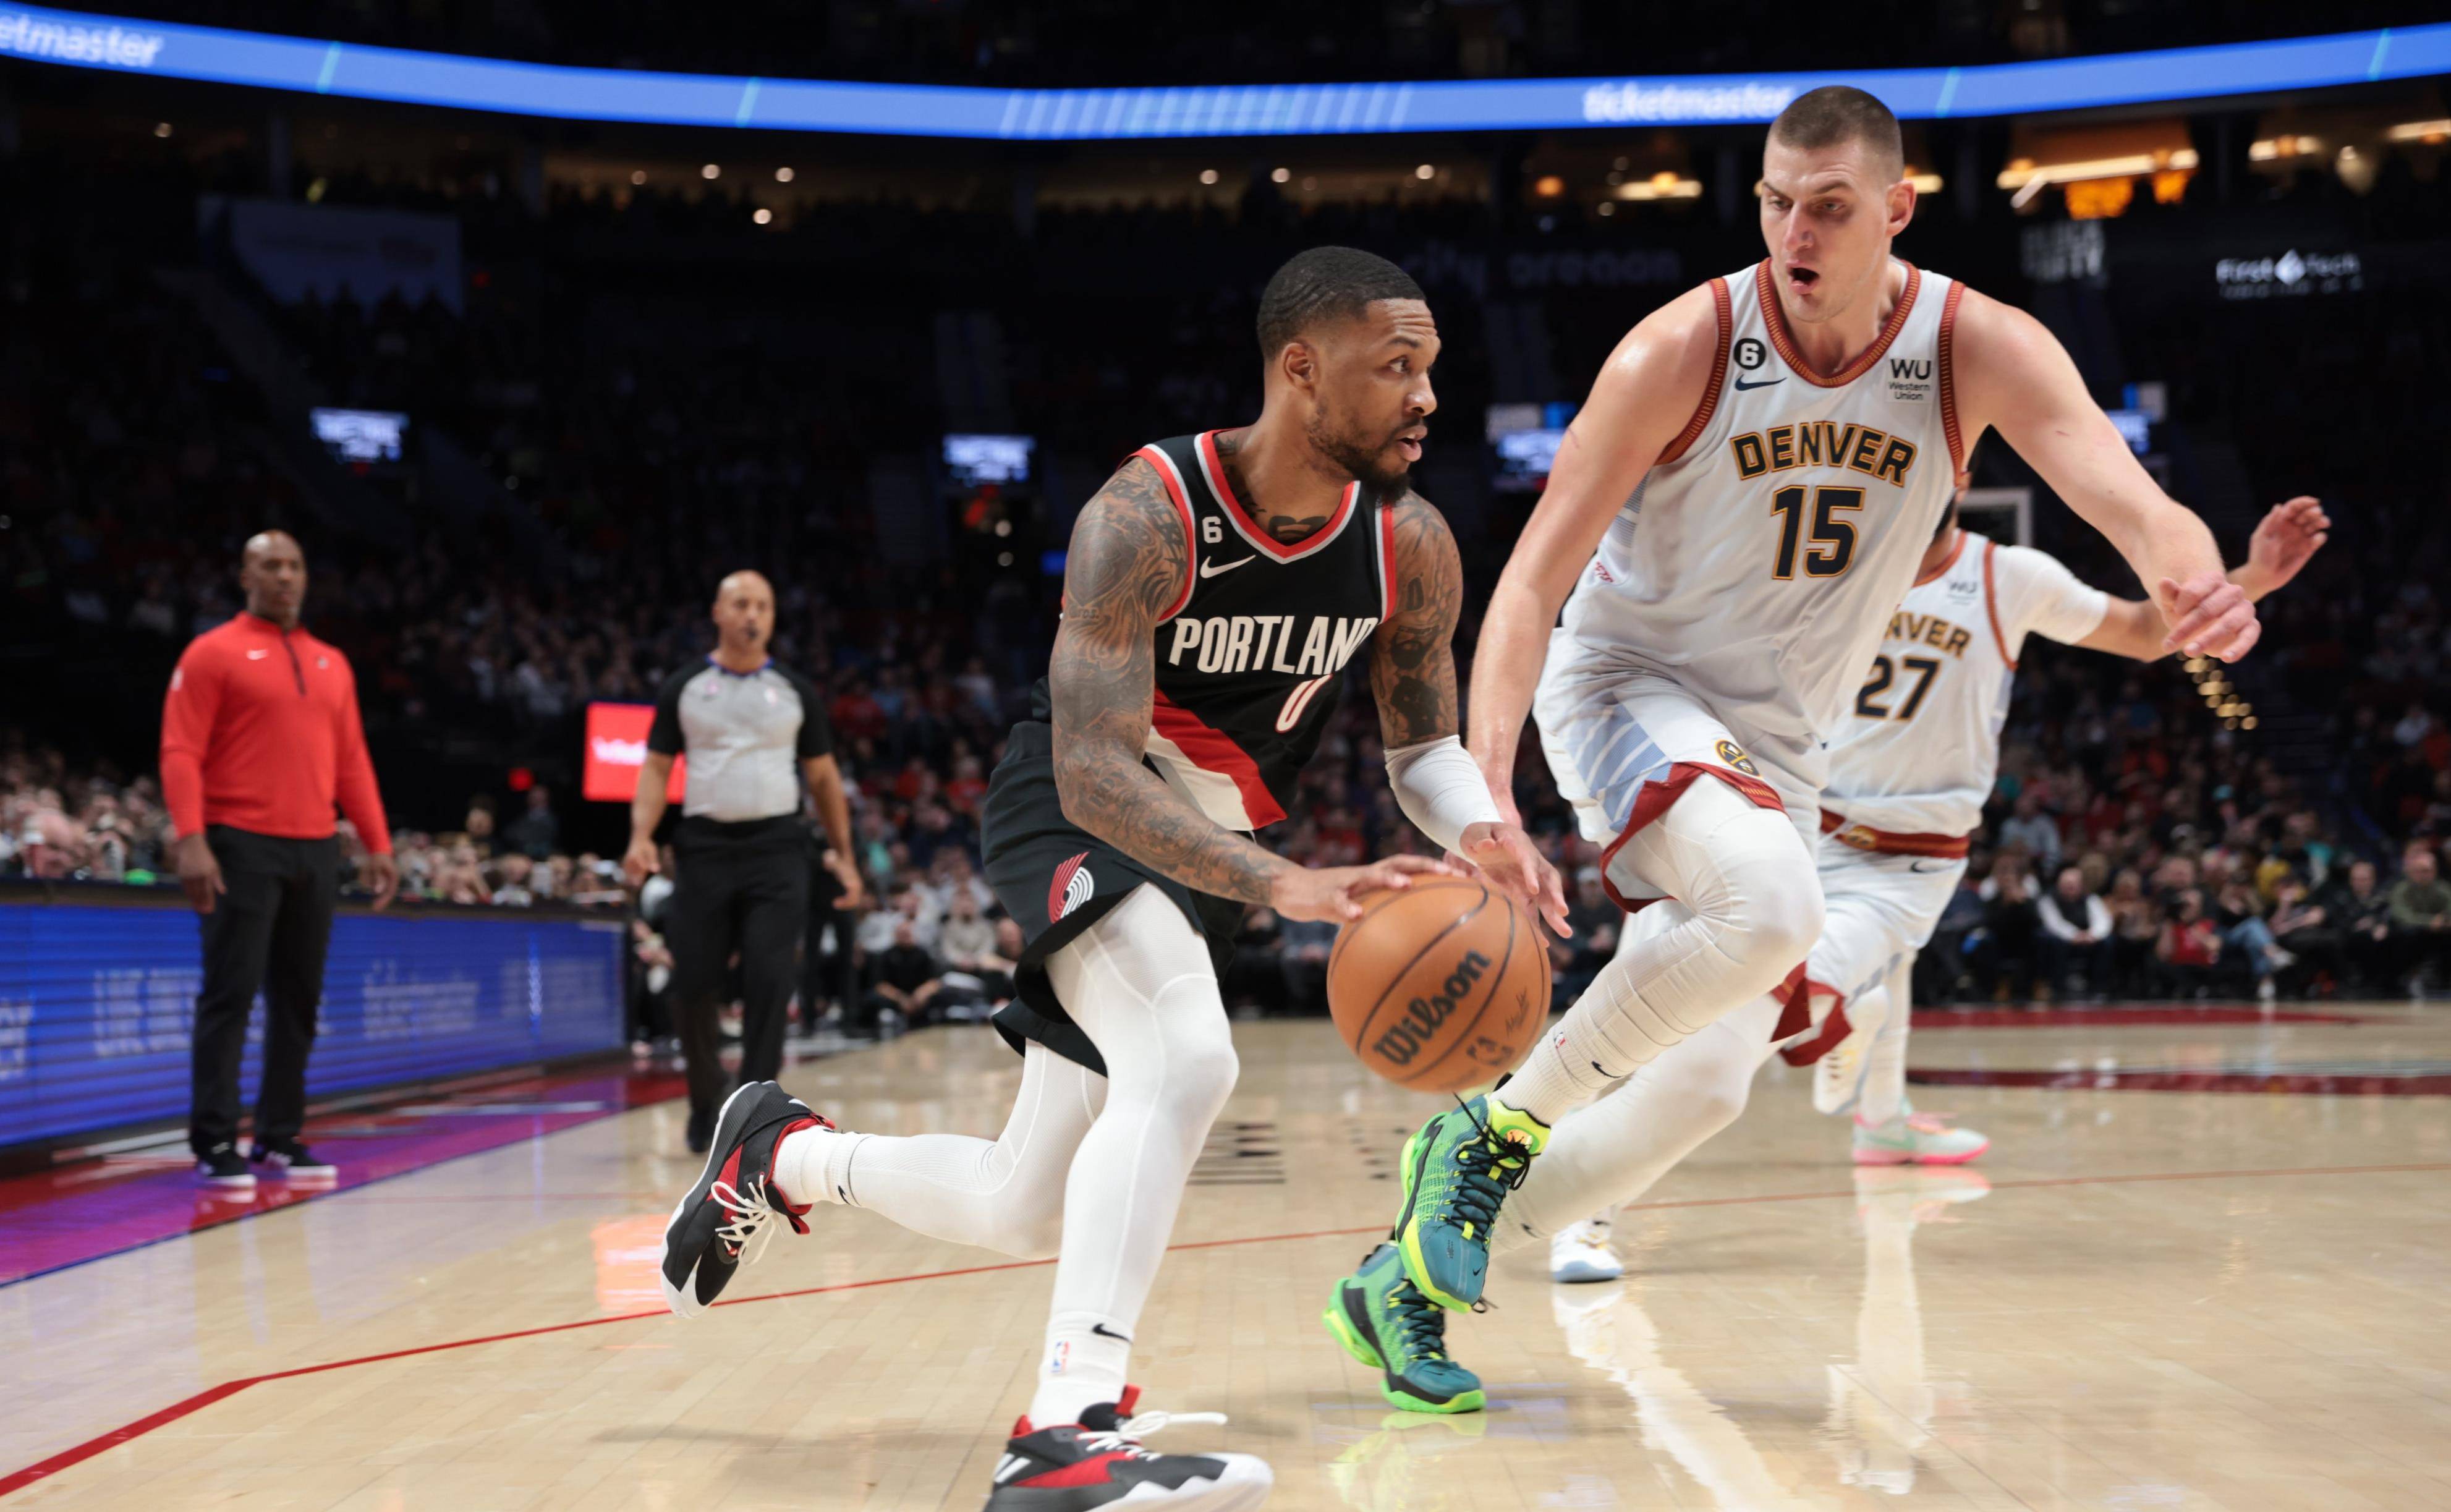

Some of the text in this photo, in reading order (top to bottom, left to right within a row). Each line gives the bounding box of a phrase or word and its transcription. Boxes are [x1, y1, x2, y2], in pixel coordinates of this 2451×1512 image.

[1740, 342, 1759, 367] 6
[1890, 359, 1931, 380] WU
[1888, 381, 1930, 391] Western
[1894, 391, 1924, 401] Union
[1730, 421, 1917, 488] DENVER
[1202, 516, 1223, 543] 6
[1770, 485, 1866, 580] 15
[1169, 616, 1378, 675] PORTLAND
[1275, 674, 1333, 733] 0
[1854, 653, 1941, 722] 27
[1372, 949, 1492, 1066] Wilson
